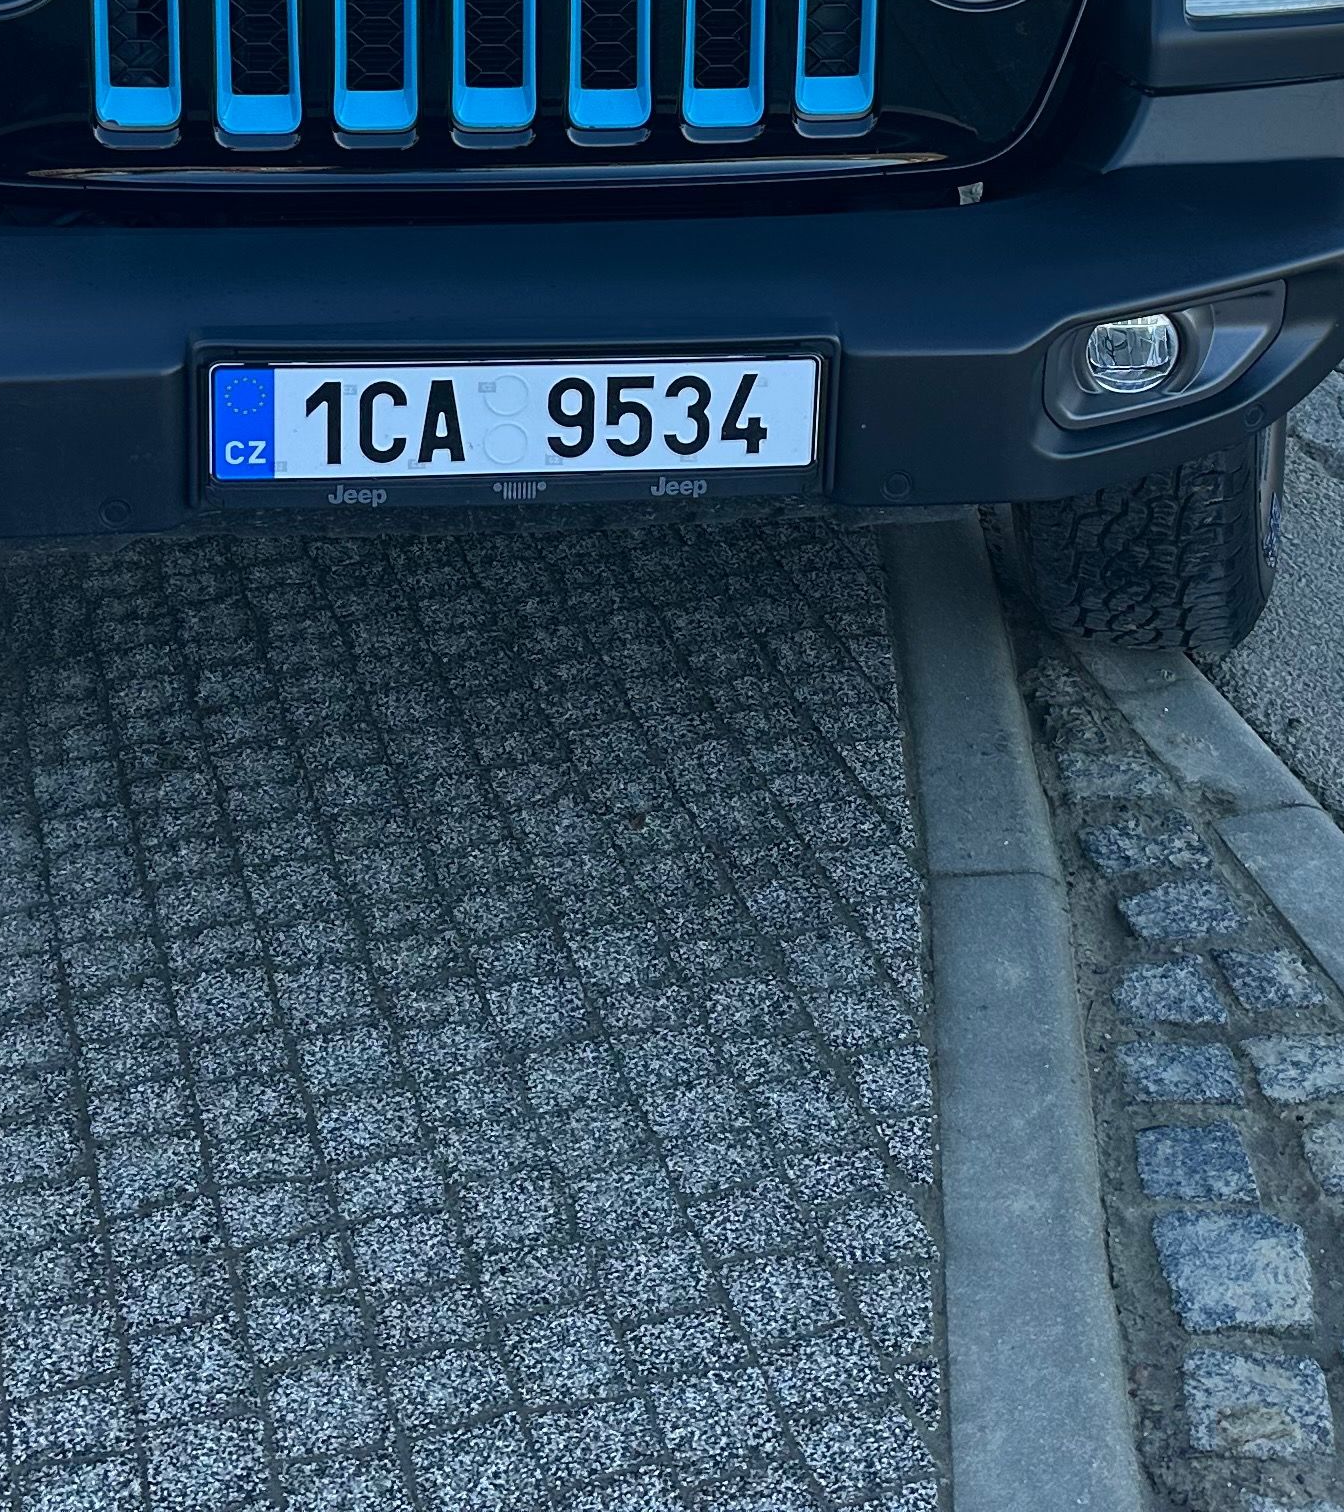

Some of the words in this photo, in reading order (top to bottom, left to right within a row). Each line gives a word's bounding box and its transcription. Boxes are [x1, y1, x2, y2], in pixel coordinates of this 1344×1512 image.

[305, 378, 465, 465] 1CA
[546, 373, 768, 459] 9534
[224, 440, 267, 465] CZ
[327, 484, 387, 508] Jeep
[650, 476, 708, 499] Jeep
